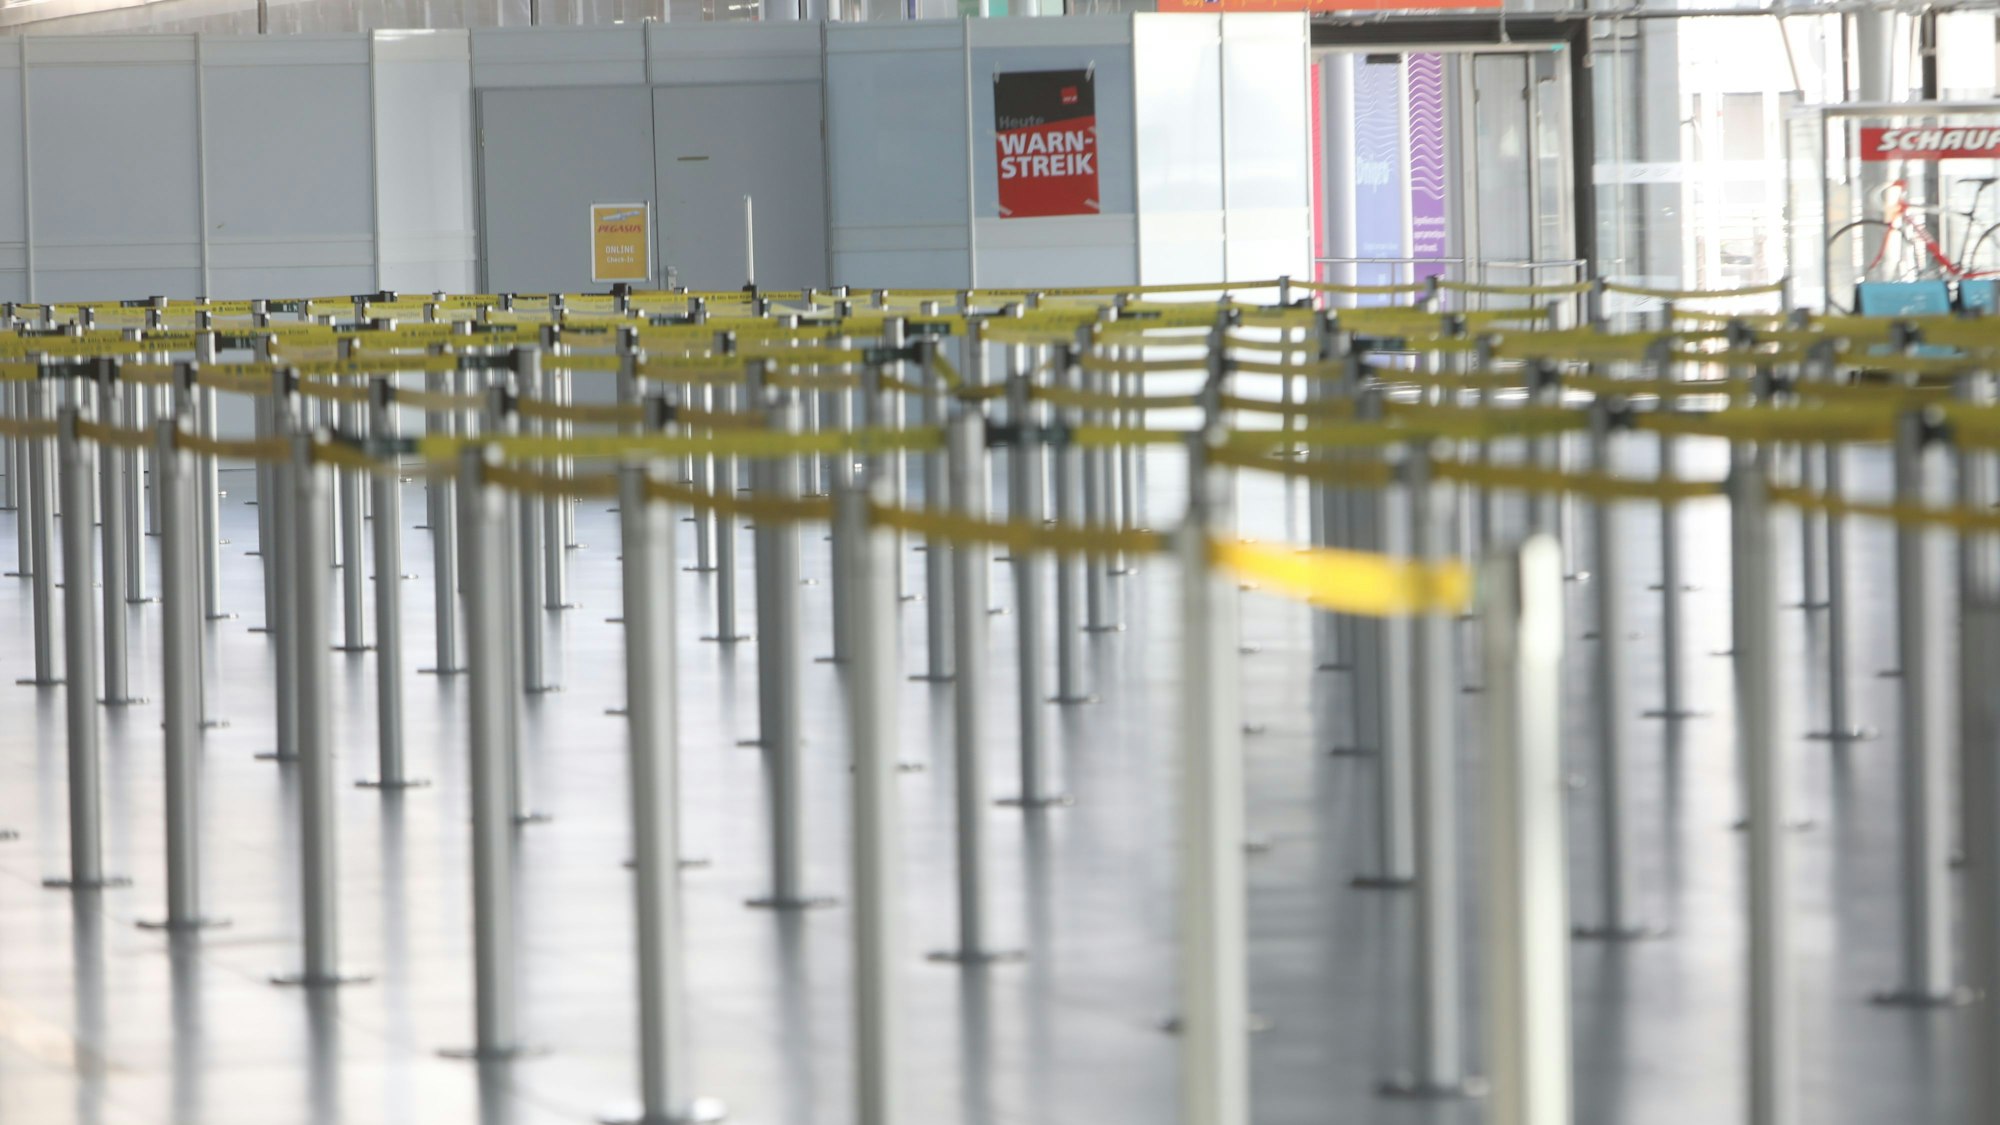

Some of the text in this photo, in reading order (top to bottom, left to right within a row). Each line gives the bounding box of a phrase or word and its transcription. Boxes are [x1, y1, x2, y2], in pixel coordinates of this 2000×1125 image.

[999, 115, 1045, 129] Heute
[999, 130, 1094, 155] WARN-
[1000, 152, 1094, 179] STREIK
[598, 224, 642, 233] PEGASUS
[605, 245, 635, 254] ONLINE
